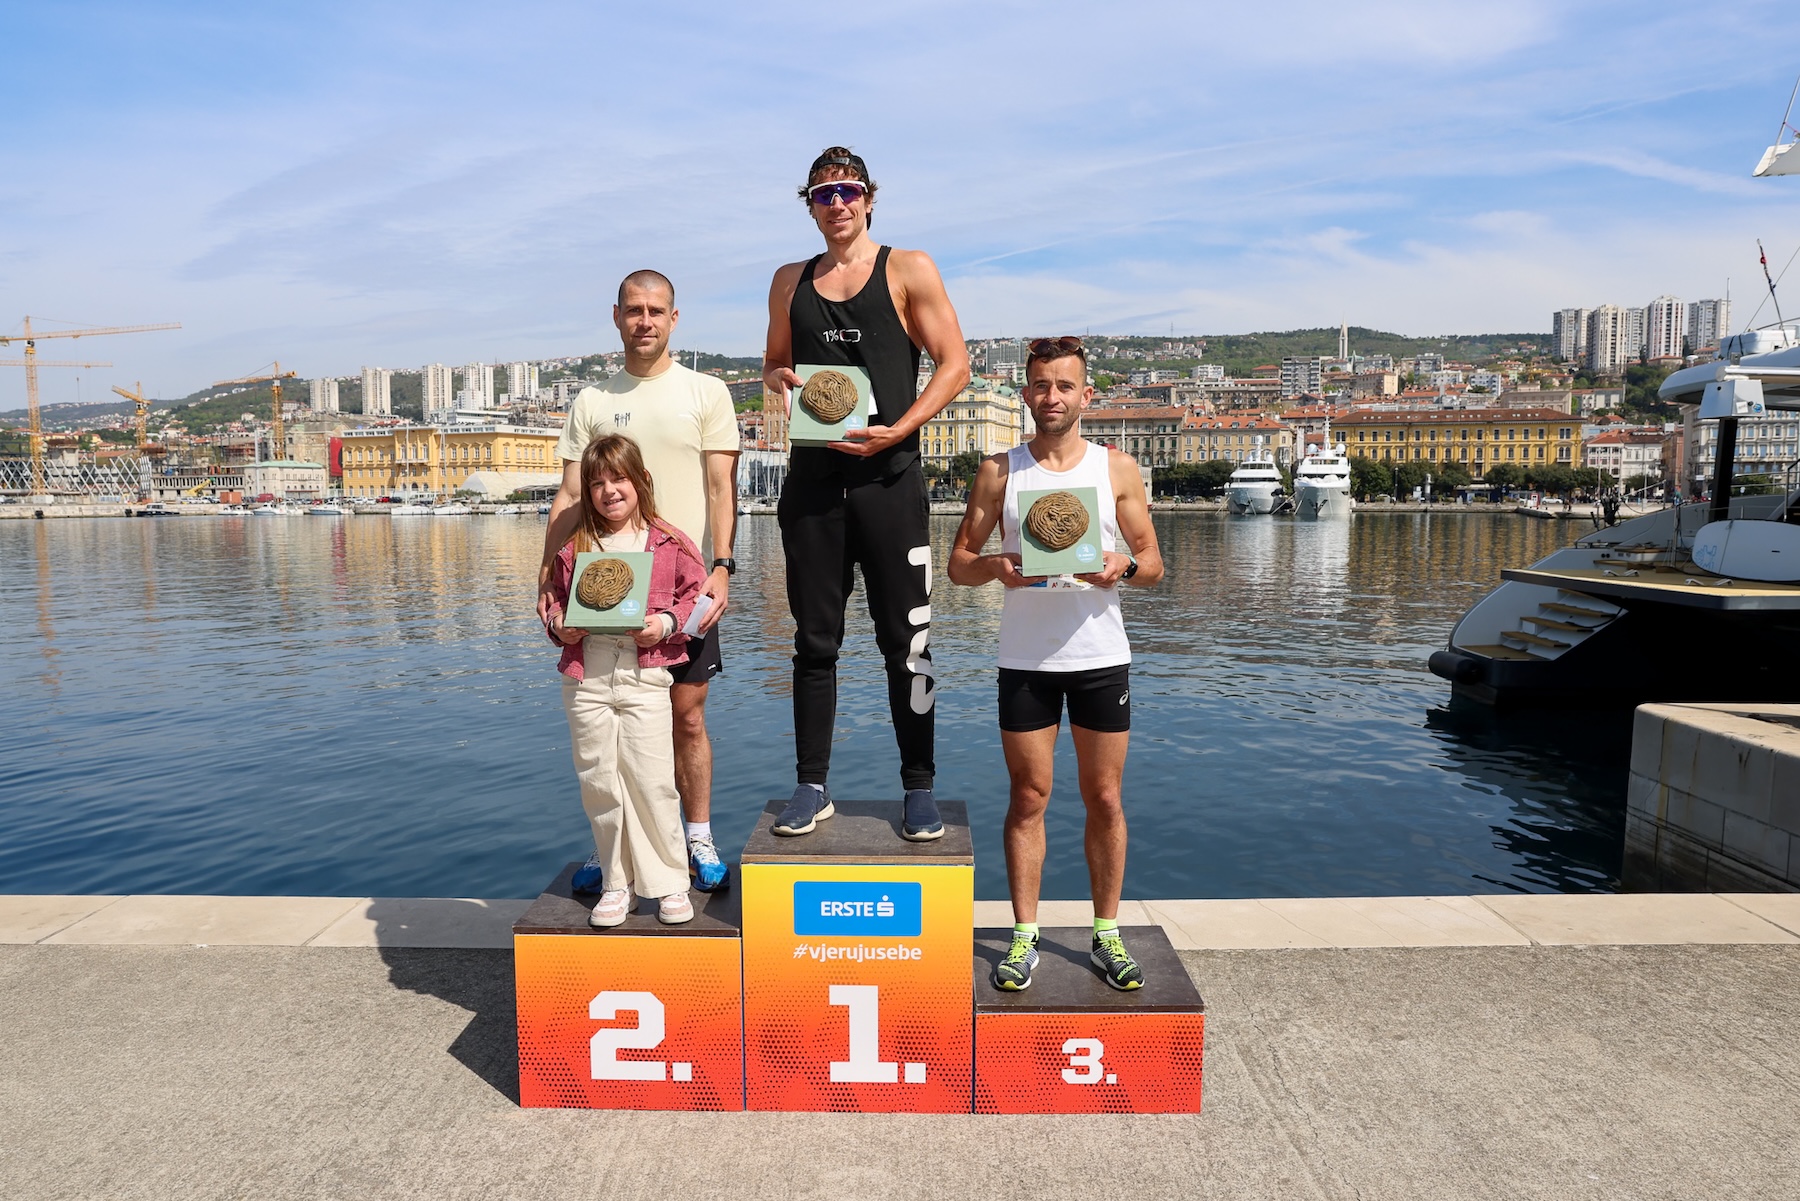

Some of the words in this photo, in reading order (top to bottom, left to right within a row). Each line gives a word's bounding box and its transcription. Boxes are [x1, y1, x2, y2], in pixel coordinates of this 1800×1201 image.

[823, 329, 840, 342] 1%
[821, 901, 874, 917] ERSTE
[793, 943, 922, 963] #vjerujusebe
[588, 990, 693, 1082] 2.
[828, 984, 927, 1084] 1.
[1061, 1038, 1117, 1085] 3.
